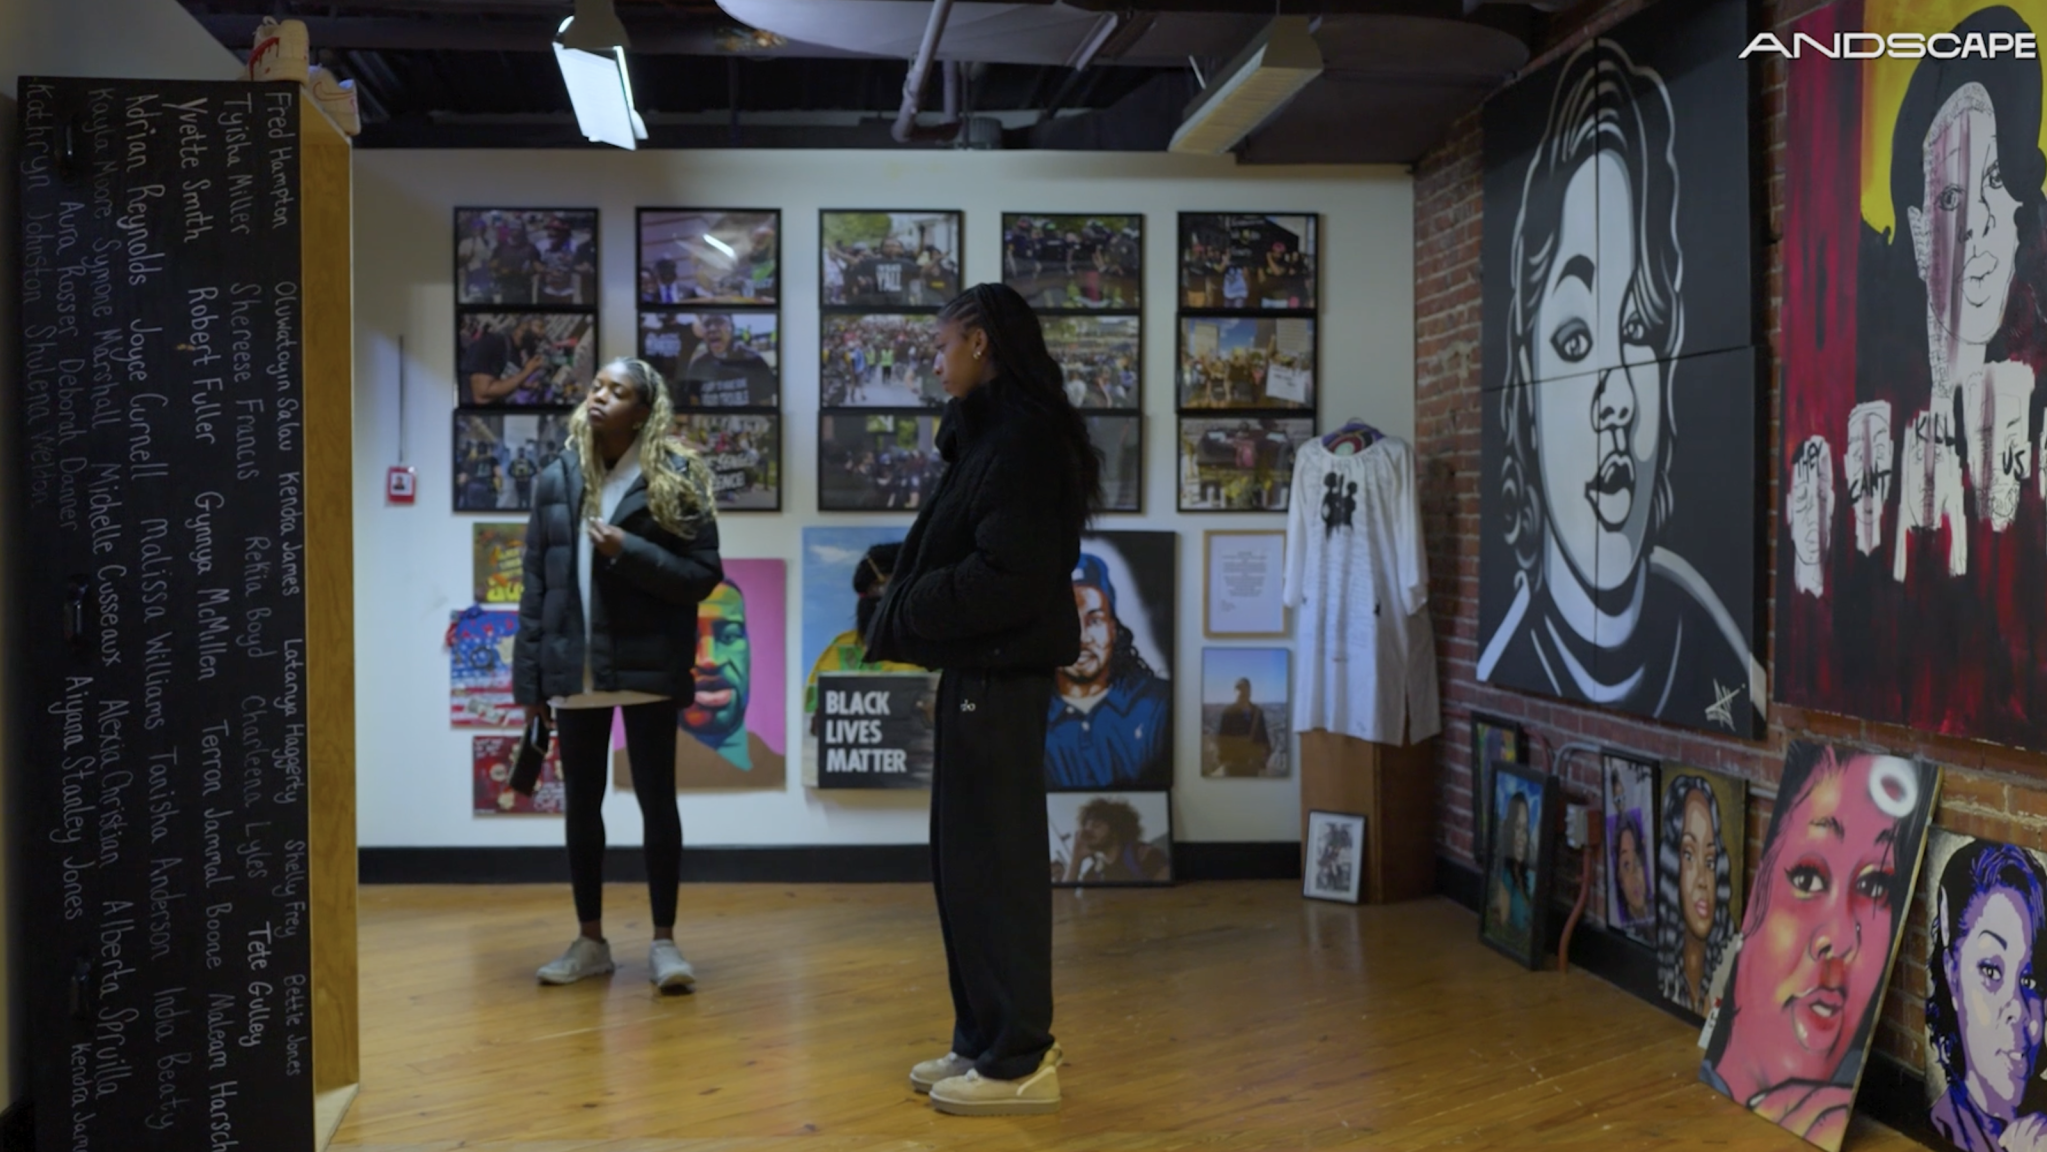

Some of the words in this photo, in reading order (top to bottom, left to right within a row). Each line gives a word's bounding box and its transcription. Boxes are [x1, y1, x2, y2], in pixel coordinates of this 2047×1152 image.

[22, 85, 56, 192] Kathryn
[83, 88, 117, 153] Kayla
[126, 95, 163, 173] Adrian
[163, 99, 209, 169] Yvette
[218, 94, 253, 168] Tyisha
[265, 93, 296, 139] Fred
[94, 161, 119, 220] Moore
[183, 180, 215, 243] Smith
[228, 175, 255, 235] Miller
[271, 148, 295, 230] Hampton
[24, 213, 55, 304] Johnston
[57, 202, 86, 256] Aura
[117, 185, 167, 286] Reynolds
[57, 266, 87, 337] Rosser
[82, 239, 122, 317] Symone
[109, 319, 164, 381] Joyce
[188, 288, 222, 366] Robert
[231, 283, 263, 383] Shereese
[267, 282, 298, 392] Oluwatoyin
[59, 360, 89, 445] Deborah
[91, 330, 124, 429] Marshall
[192, 379, 224, 445] Fuller
[130, 393, 170, 481] Curnell
[236, 399, 266, 481] Francis
[277, 399, 300, 451] Salau
[1795, 441, 1823, 483] THEY
[1848, 463, 1892, 504] CANT
[1914, 414, 1955, 446] KILL
[2002, 448, 2026, 481] US
[60, 458, 89, 531] Danner
[88, 464, 125, 555] Michelle
[280, 472, 301, 537] Kendra
[244, 537, 272, 598] Rekia
[282, 542, 303, 597] James
[98, 565, 128, 667] Cusseaux
[197, 589, 231, 681] McMillen
[236, 608, 279, 658] Boyd
[48, 677, 95, 751] Aiyana
[144, 632, 174, 730] Williams
[273, 639, 303, 718] Latanya
[825, 690, 891, 715] BLACK
[99, 700, 131, 765] Alexia
[202, 720, 231, 797] Terron
[242, 696, 271, 808] Charleena
[272, 725, 303, 804] Haggerty
[825, 719, 882, 744] LIVES
[826, 748, 907, 773] MATTER
[50, 757, 97, 843] Stanley
[100, 771, 135, 869] Christian
[149, 746, 183, 844] Tanisha
[204, 809, 236, 888] Jammal
[237, 823, 273, 879] Lyles
[272, 840, 307, 897] Shelly
[63, 857, 97, 921] Jones
[150, 858, 187, 962] Anderson
[273, 903, 304, 938] Frey
[101, 901, 137, 999] Alberta
[206, 903, 233, 970] Boone
[248, 922, 274, 971] Tete
[155, 988, 194, 1043] India
[239, 982, 275, 1047] Gulley
[284, 975, 307, 1027] Bettie
[71, 1044, 94, 1108] Kendra
[145, 1053, 193, 1129] Beaty
[286, 1036, 308, 1077] Jones
